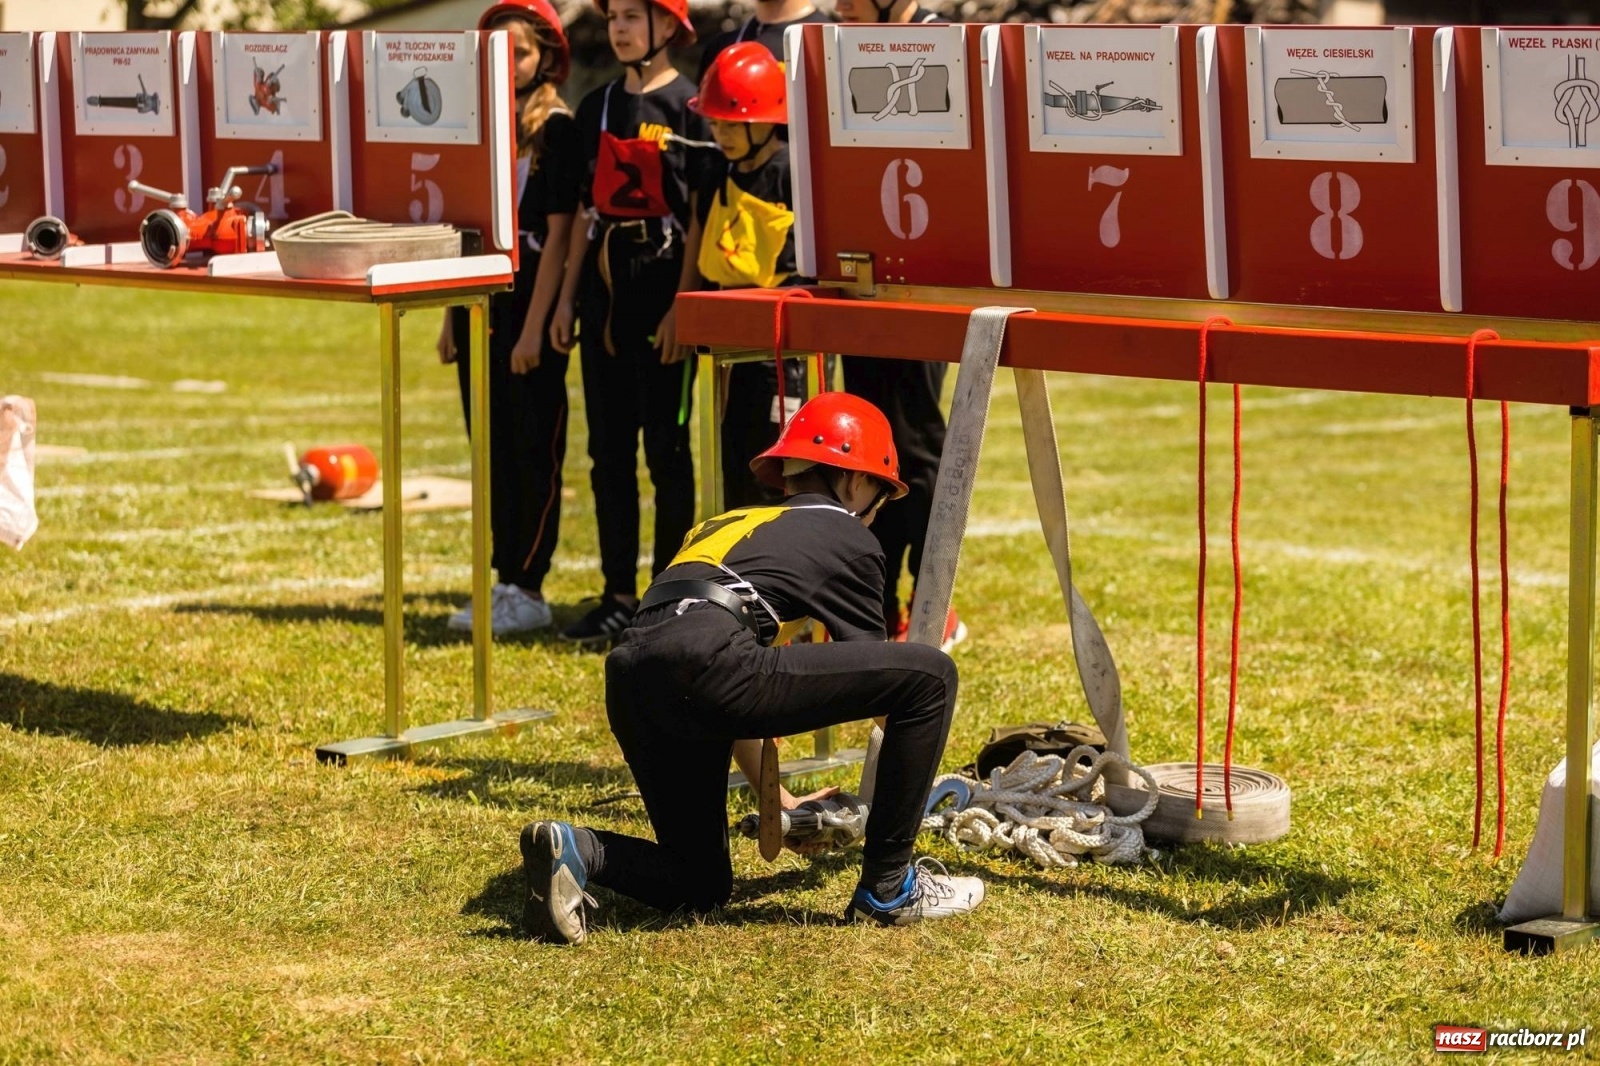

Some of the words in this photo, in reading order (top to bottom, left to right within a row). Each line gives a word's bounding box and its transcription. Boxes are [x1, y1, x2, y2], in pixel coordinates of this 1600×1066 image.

[244, 44, 288, 52] ROZDZIELACZ
[386, 41, 401, 51] WĄŻ
[405, 42, 435, 50] TŁOCZNY
[439, 42, 455, 50] W-52
[858, 43, 886, 54] WĘZEŁ
[890, 44, 936, 52] MASZTOWY
[1508, 38, 1546, 50] WĘZEŁ
[1552, 38, 1592, 49] PŁASKI
[85, 46, 124, 56] PRĄDOWNICA
[126, 47, 159, 55] ZAMYKANA
[1046, 51, 1076, 62] WĘZEŁ
[1080, 52, 1092, 60] NA
[1096, 52, 1155, 62] PRĄDOWNICY
[1287, 48, 1318, 60] WĘZEŁ
[1323, 48, 1374, 58] CIESIELSKI
[113, 58, 131, 66] PW-52
[388, 53, 412, 62] SPIĘTY
[413, 53, 454, 61] NOSZAKIEM
[113, 144, 145, 214] 3
[255, 149, 291, 219] 4
[409, 152, 444, 223] 5
[610, 163, 649, 208] 2
[881, 158, 929, 240] 6
[1088, 165, 1130, 248] 7
[1309, 171, 1364, 260] 8
[1546, 178, 1600, 271] 9
